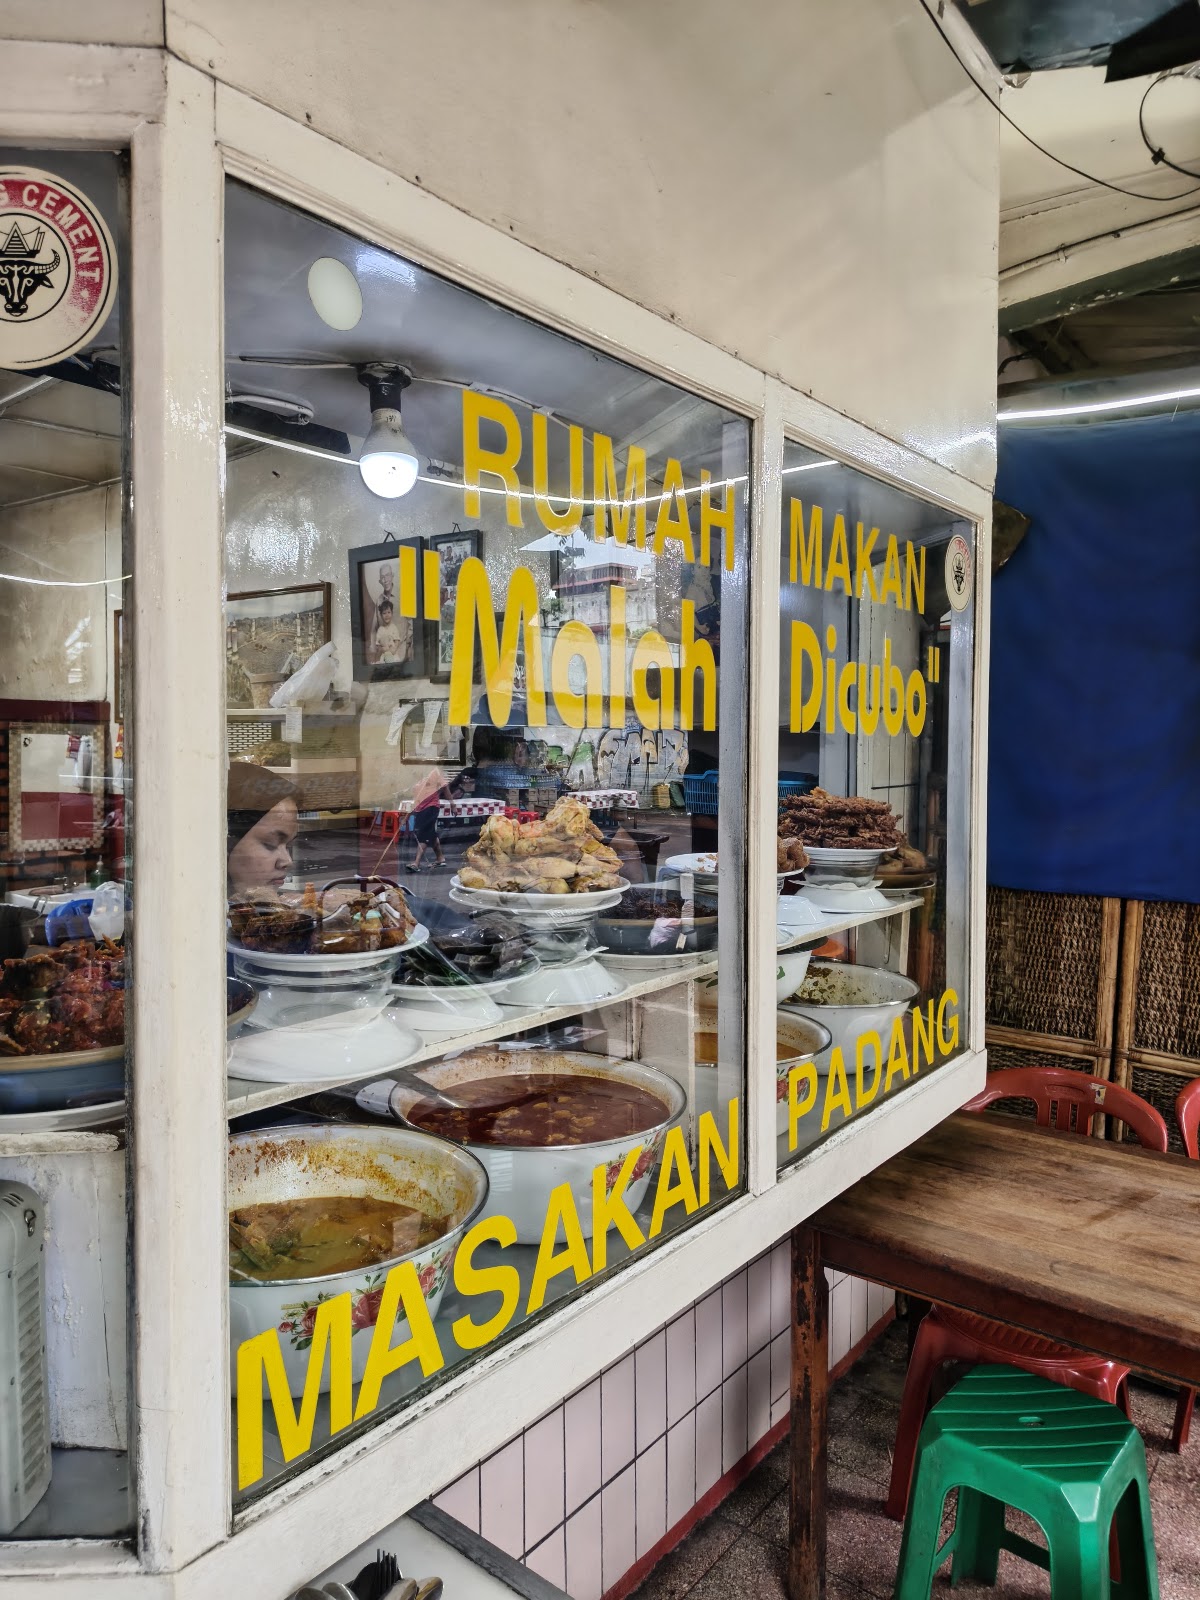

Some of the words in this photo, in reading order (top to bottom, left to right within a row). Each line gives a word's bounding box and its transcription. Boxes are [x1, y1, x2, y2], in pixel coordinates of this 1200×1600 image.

[22, 184, 100, 284] CEMENT
[462, 389, 735, 572] RUMAH
[789, 496, 926, 615] MAKAN
[398, 545, 717, 732] "Malah
[790, 619, 940, 738] Dicubo"
[237, 1096, 740, 1492] MASAKAN
[788, 987, 960, 1152] PADANG
